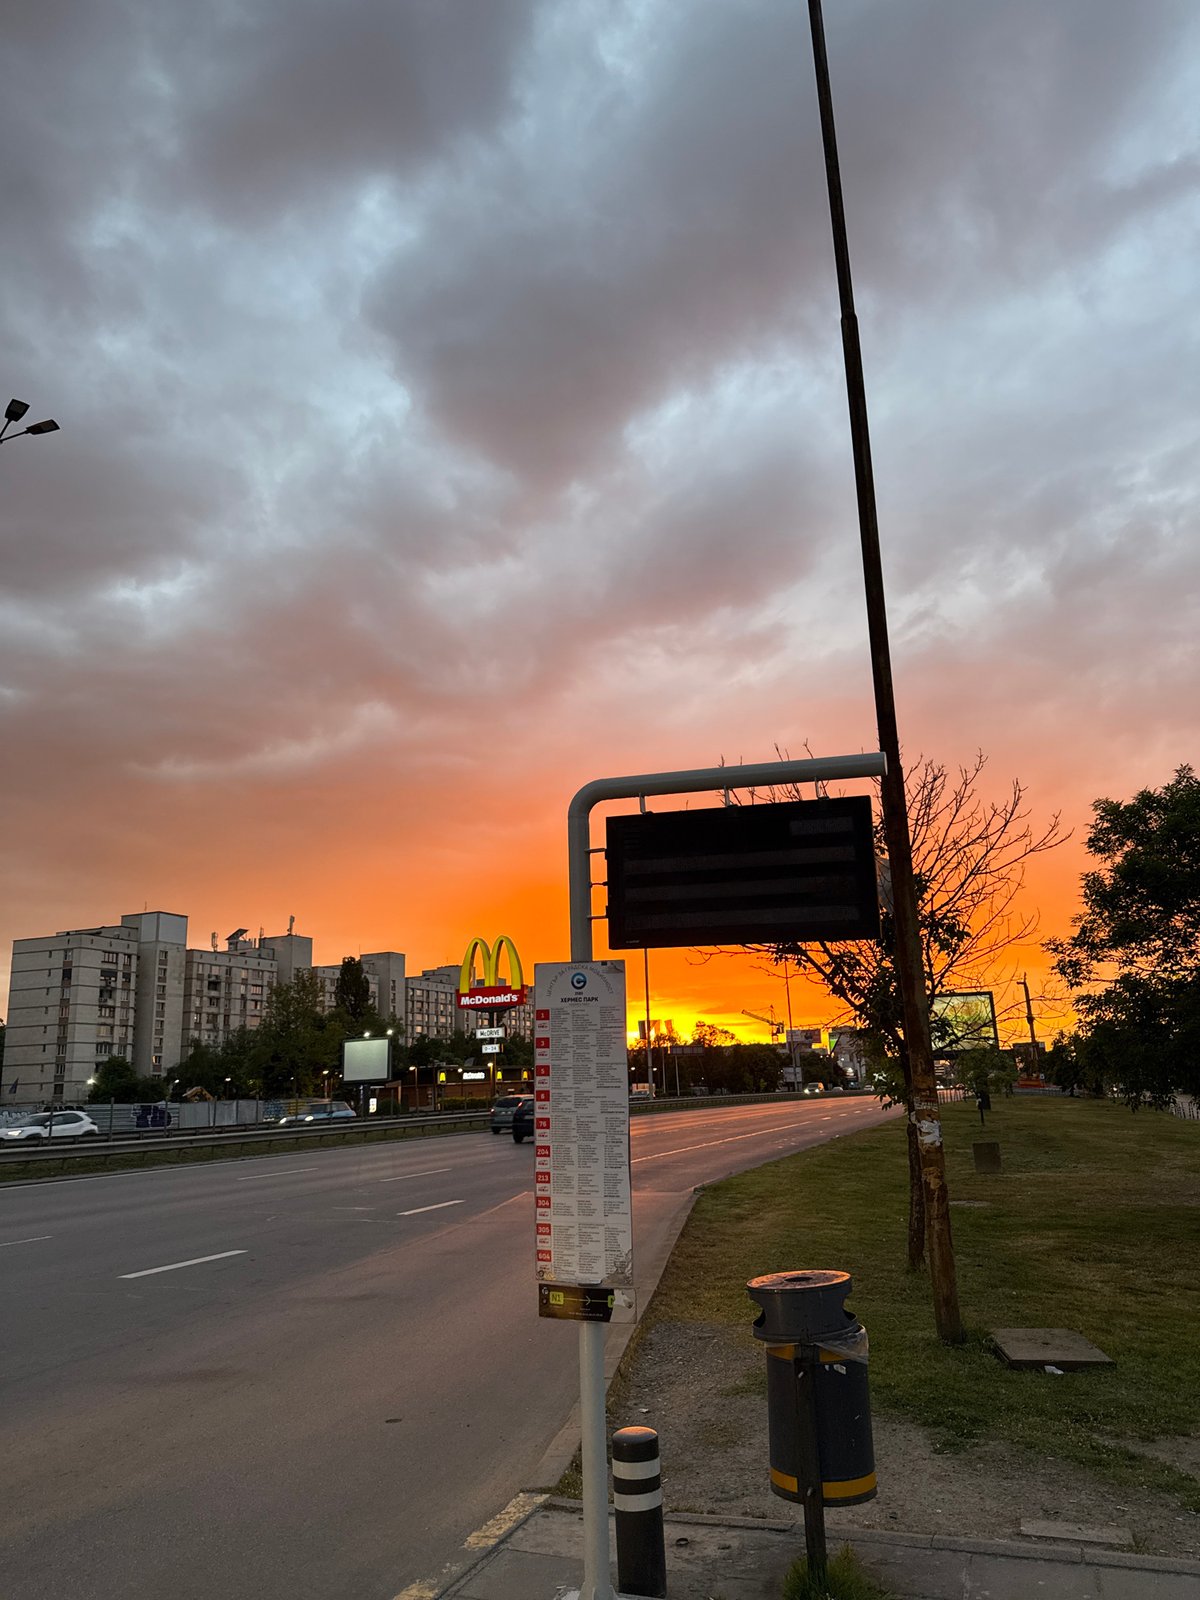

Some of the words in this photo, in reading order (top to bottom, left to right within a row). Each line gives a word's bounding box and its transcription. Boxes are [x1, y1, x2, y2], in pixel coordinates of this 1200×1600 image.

[460, 993, 518, 1005] McDonald's
[479, 1029, 500, 1037] McDRIVE
[551, 1293, 562, 1302] N1
